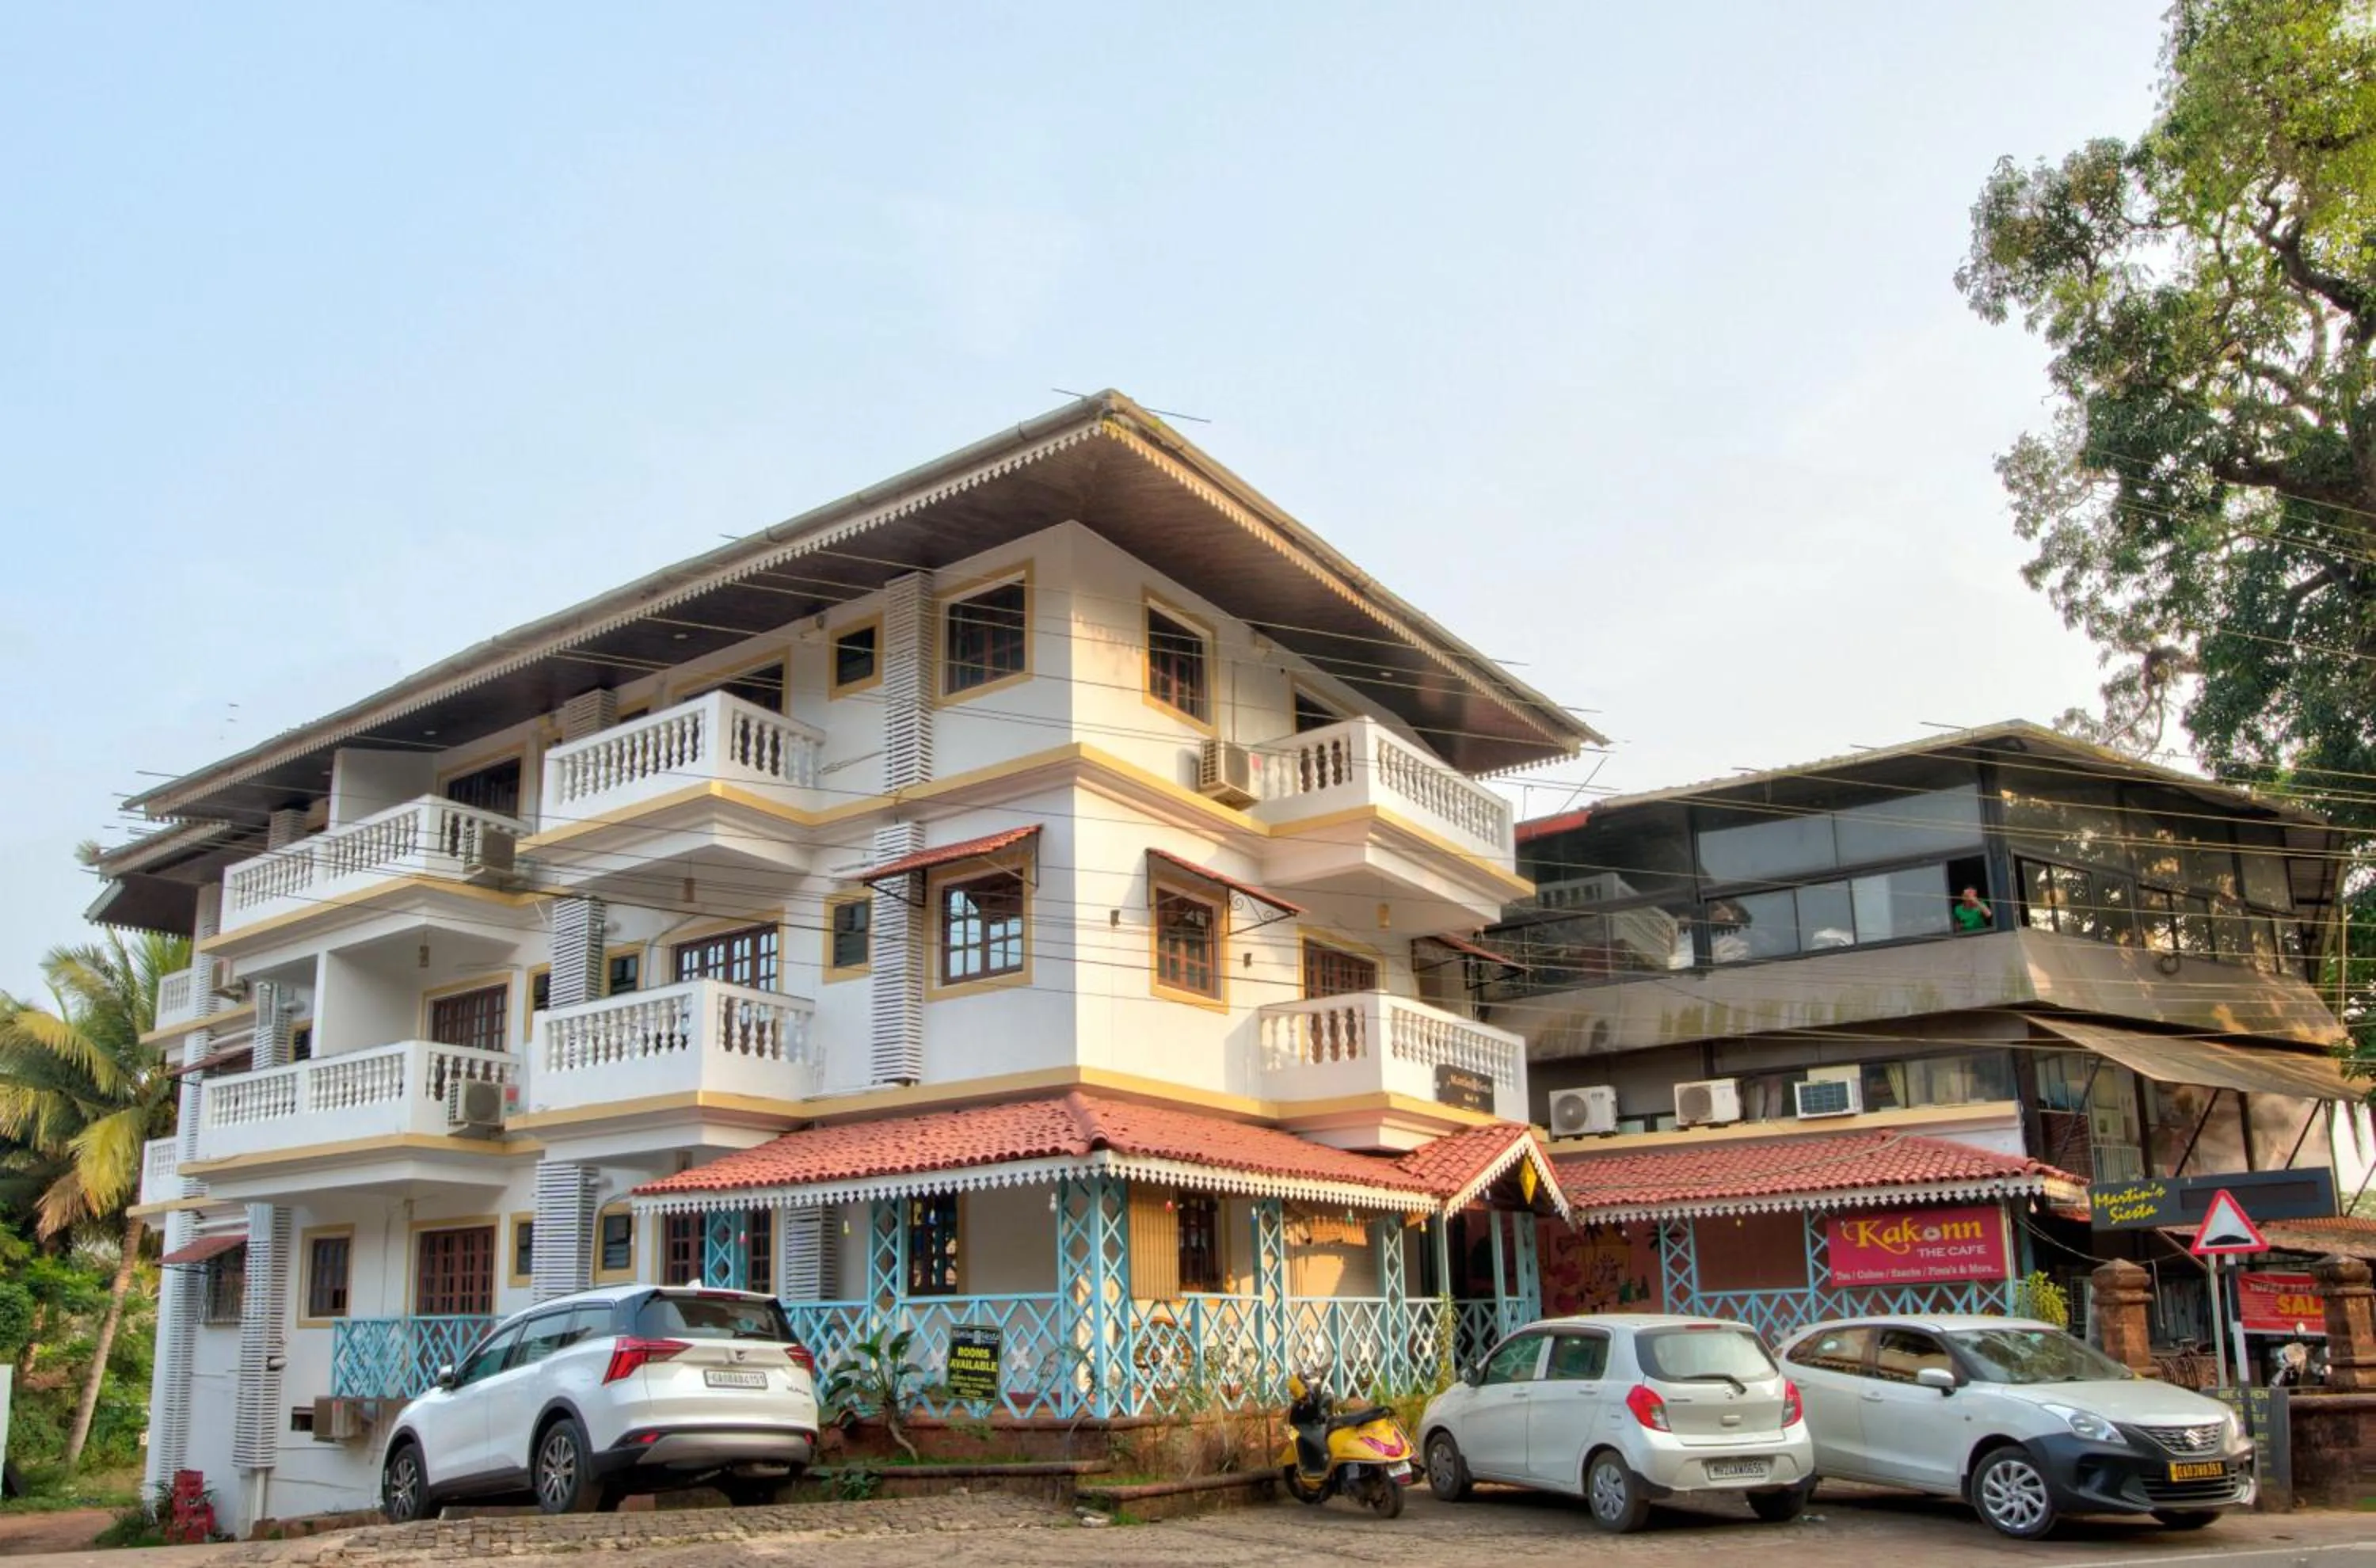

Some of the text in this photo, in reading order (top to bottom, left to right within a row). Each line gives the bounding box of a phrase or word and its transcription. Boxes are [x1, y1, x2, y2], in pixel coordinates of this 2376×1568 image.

[2094, 1182, 2166, 1210] Martin's
[2109, 1204, 2158, 1225] Siesta
[1842, 1217, 1983, 1255] Kakonn
[1917, 1244, 1987, 1258] THE CAFE
[2276, 1292, 2325, 1315] SAL
[958, 1346, 990, 1359] ROOMS
[949, 1357, 999, 1373] AVAILABLE
